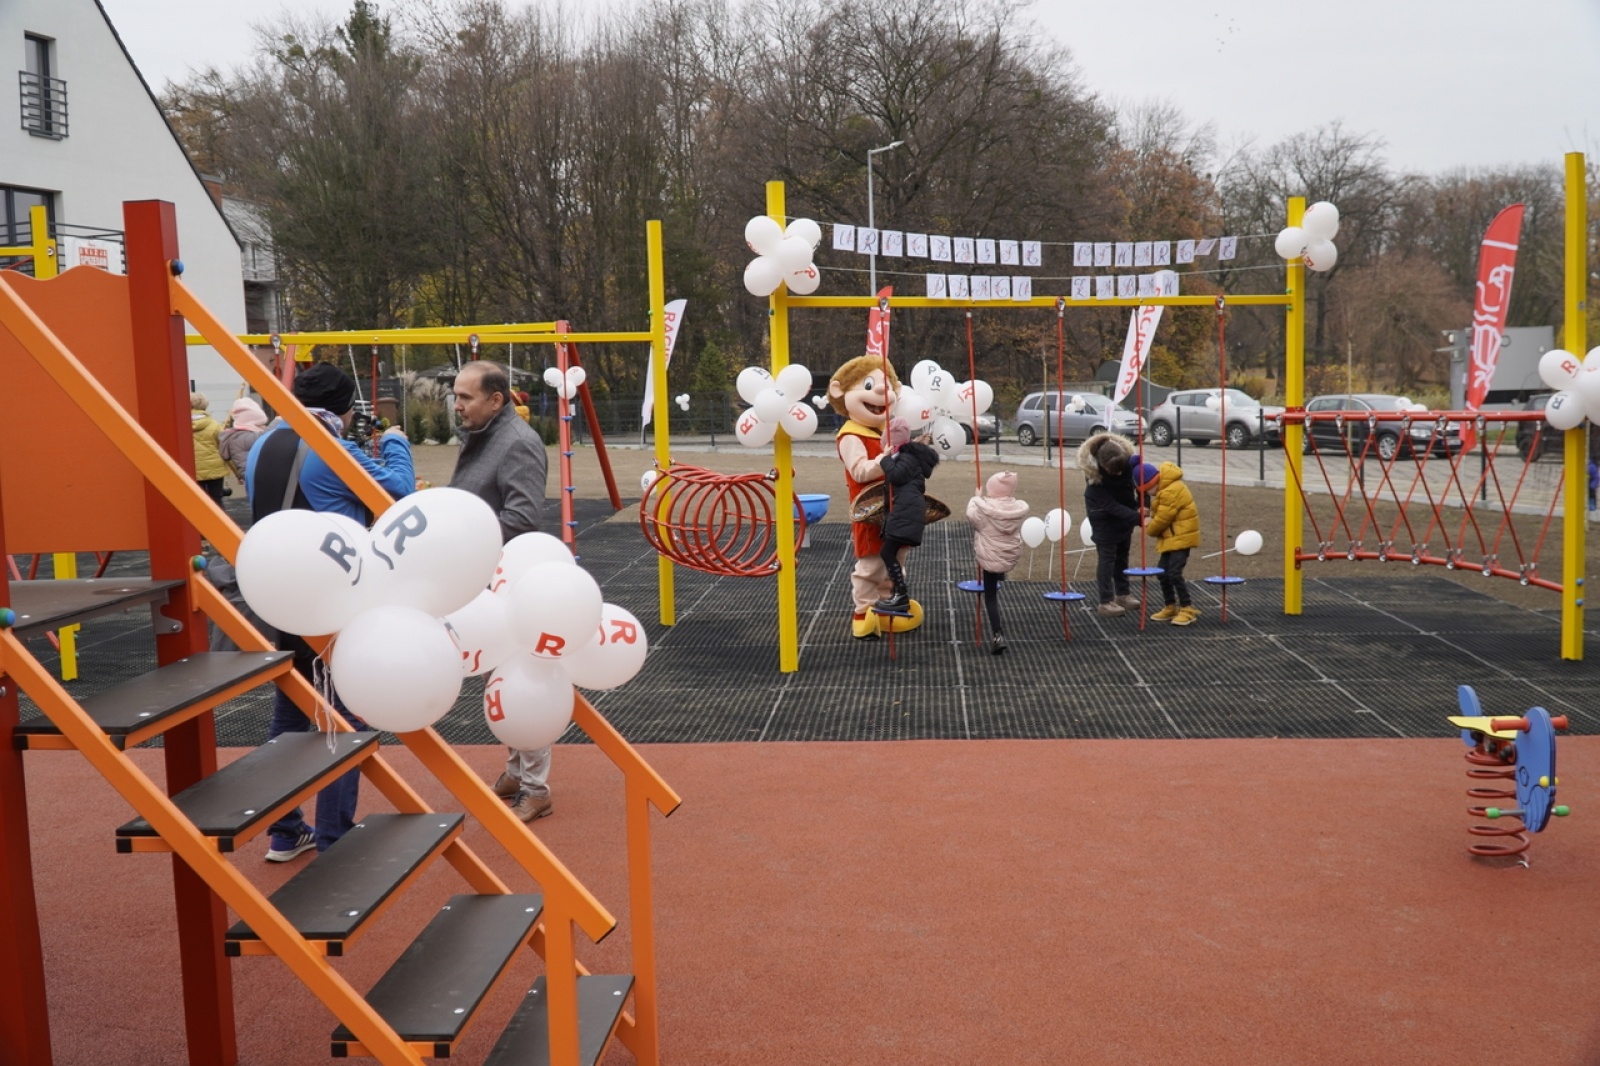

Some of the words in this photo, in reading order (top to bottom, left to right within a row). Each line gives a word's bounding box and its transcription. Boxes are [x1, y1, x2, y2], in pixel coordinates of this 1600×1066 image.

[931, 375, 942, 388] R
[740, 418, 754, 435] R
[792, 408, 807, 422] R
[938, 438, 951, 451] R
[382, 504, 428, 556] R
[319, 531, 357, 574] R
[534, 632, 566, 657] R
[610, 619, 637, 645] R
[485, 689, 506, 722] R
